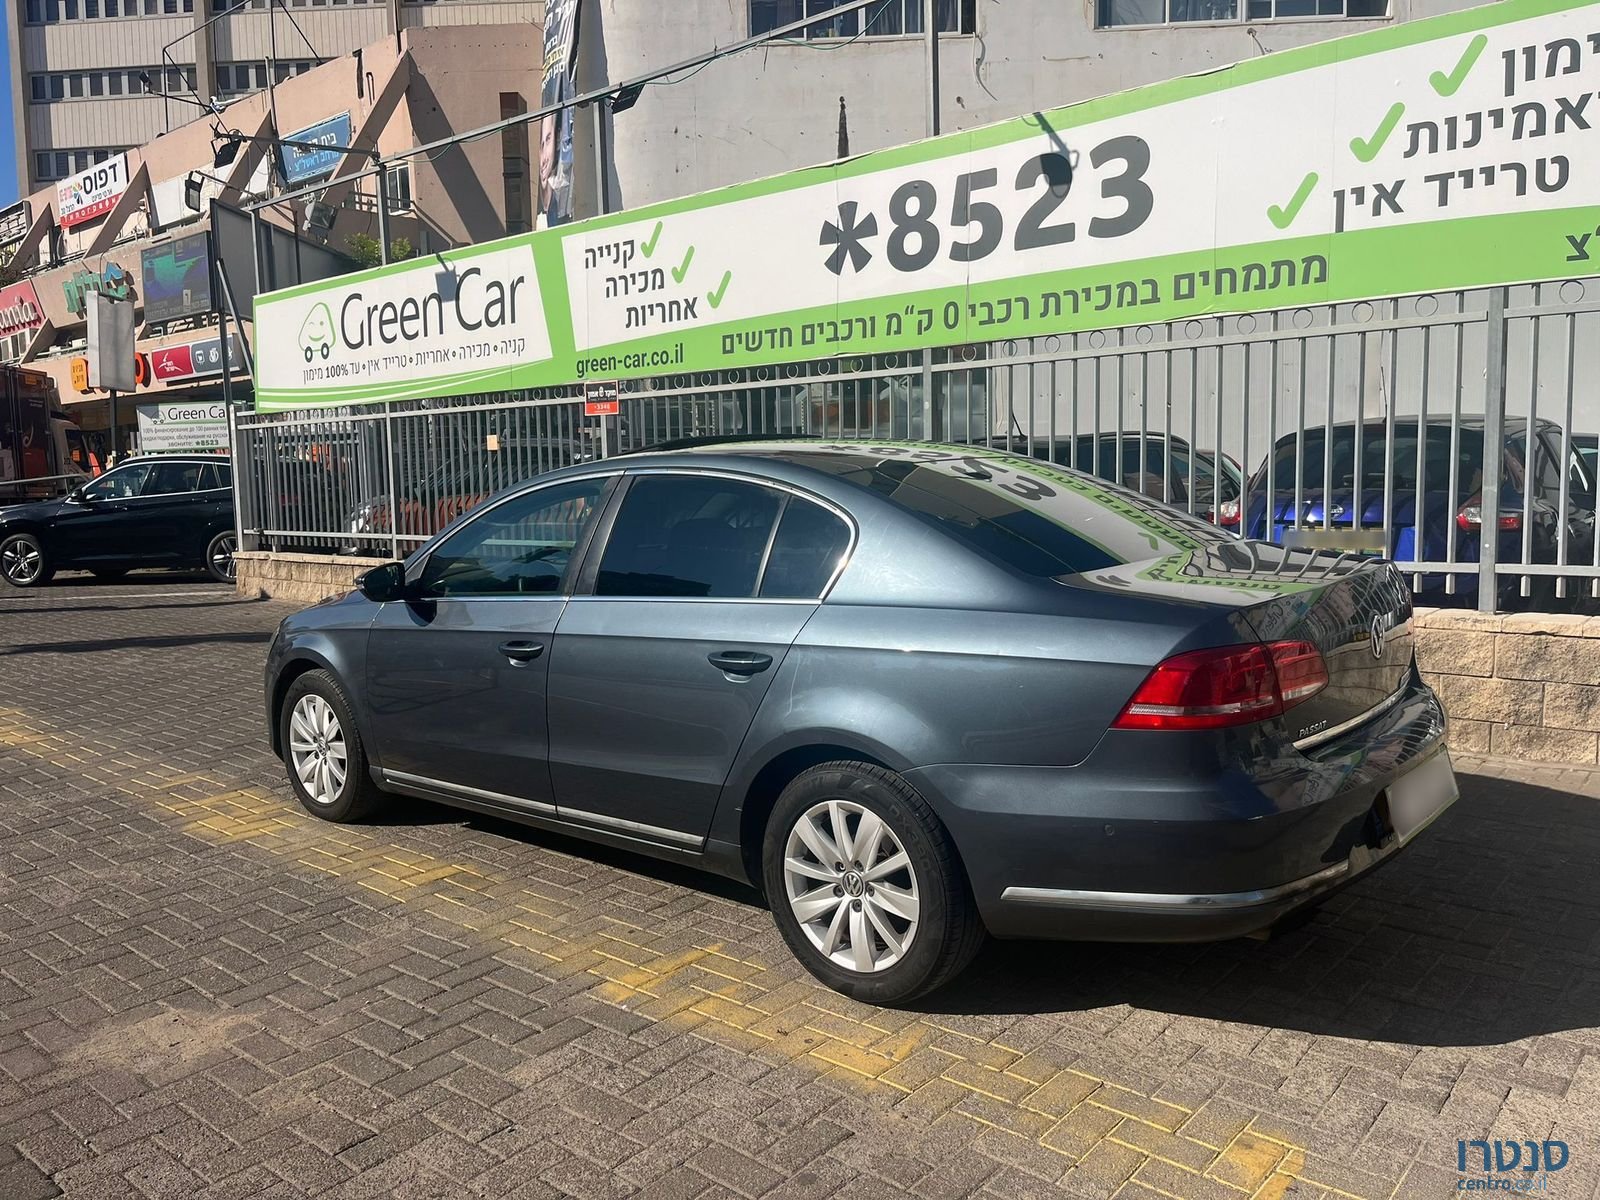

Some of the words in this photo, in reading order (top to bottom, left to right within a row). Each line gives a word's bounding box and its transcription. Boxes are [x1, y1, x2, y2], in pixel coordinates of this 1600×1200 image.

[1502, 32, 1600, 97] ימון
[1403, 91, 1600, 159] אמינות
[83, 162, 118, 195] דפוס
[1425, 155, 1570, 207] טרייד
[1333, 179, 1406, 233] אין
[585, 239, 635, 269] קנייה
[606, 267, 665, 298] מכירה
[1173, 254, 1328, 301] מתמחים
[340, 292, 445, 350] Green
[455, 267, 526, 332] Car
[625, 296, 699, 329] אחריות
[968, 294, 1030, 326] רכבי
[1040, 277, 1161, 318] במכירת
[942, 300, 960, 330] 0
[721, 326, 794, 355] חדשים
[801, 317, 877, 345] ורכבים
[382, 353, 407, 368] טרייד
[415, 348, 450, 366] אחריות
[459, 343, 492, 360] מכירה
[500, 337, 526, 357] קניה
[576, 343, 684, 378] green-car.co.il
[302, 366, 324, 385] מימון
[325, 363, 349, 379] 100%
[350, 361, 361, 375] עד
[367, 356, 381, 374] אין
[168, 407, 206, 421] Green
[208, 405, 226, 419] Ca
[1299, 719, 1328, 738] PASSAT
